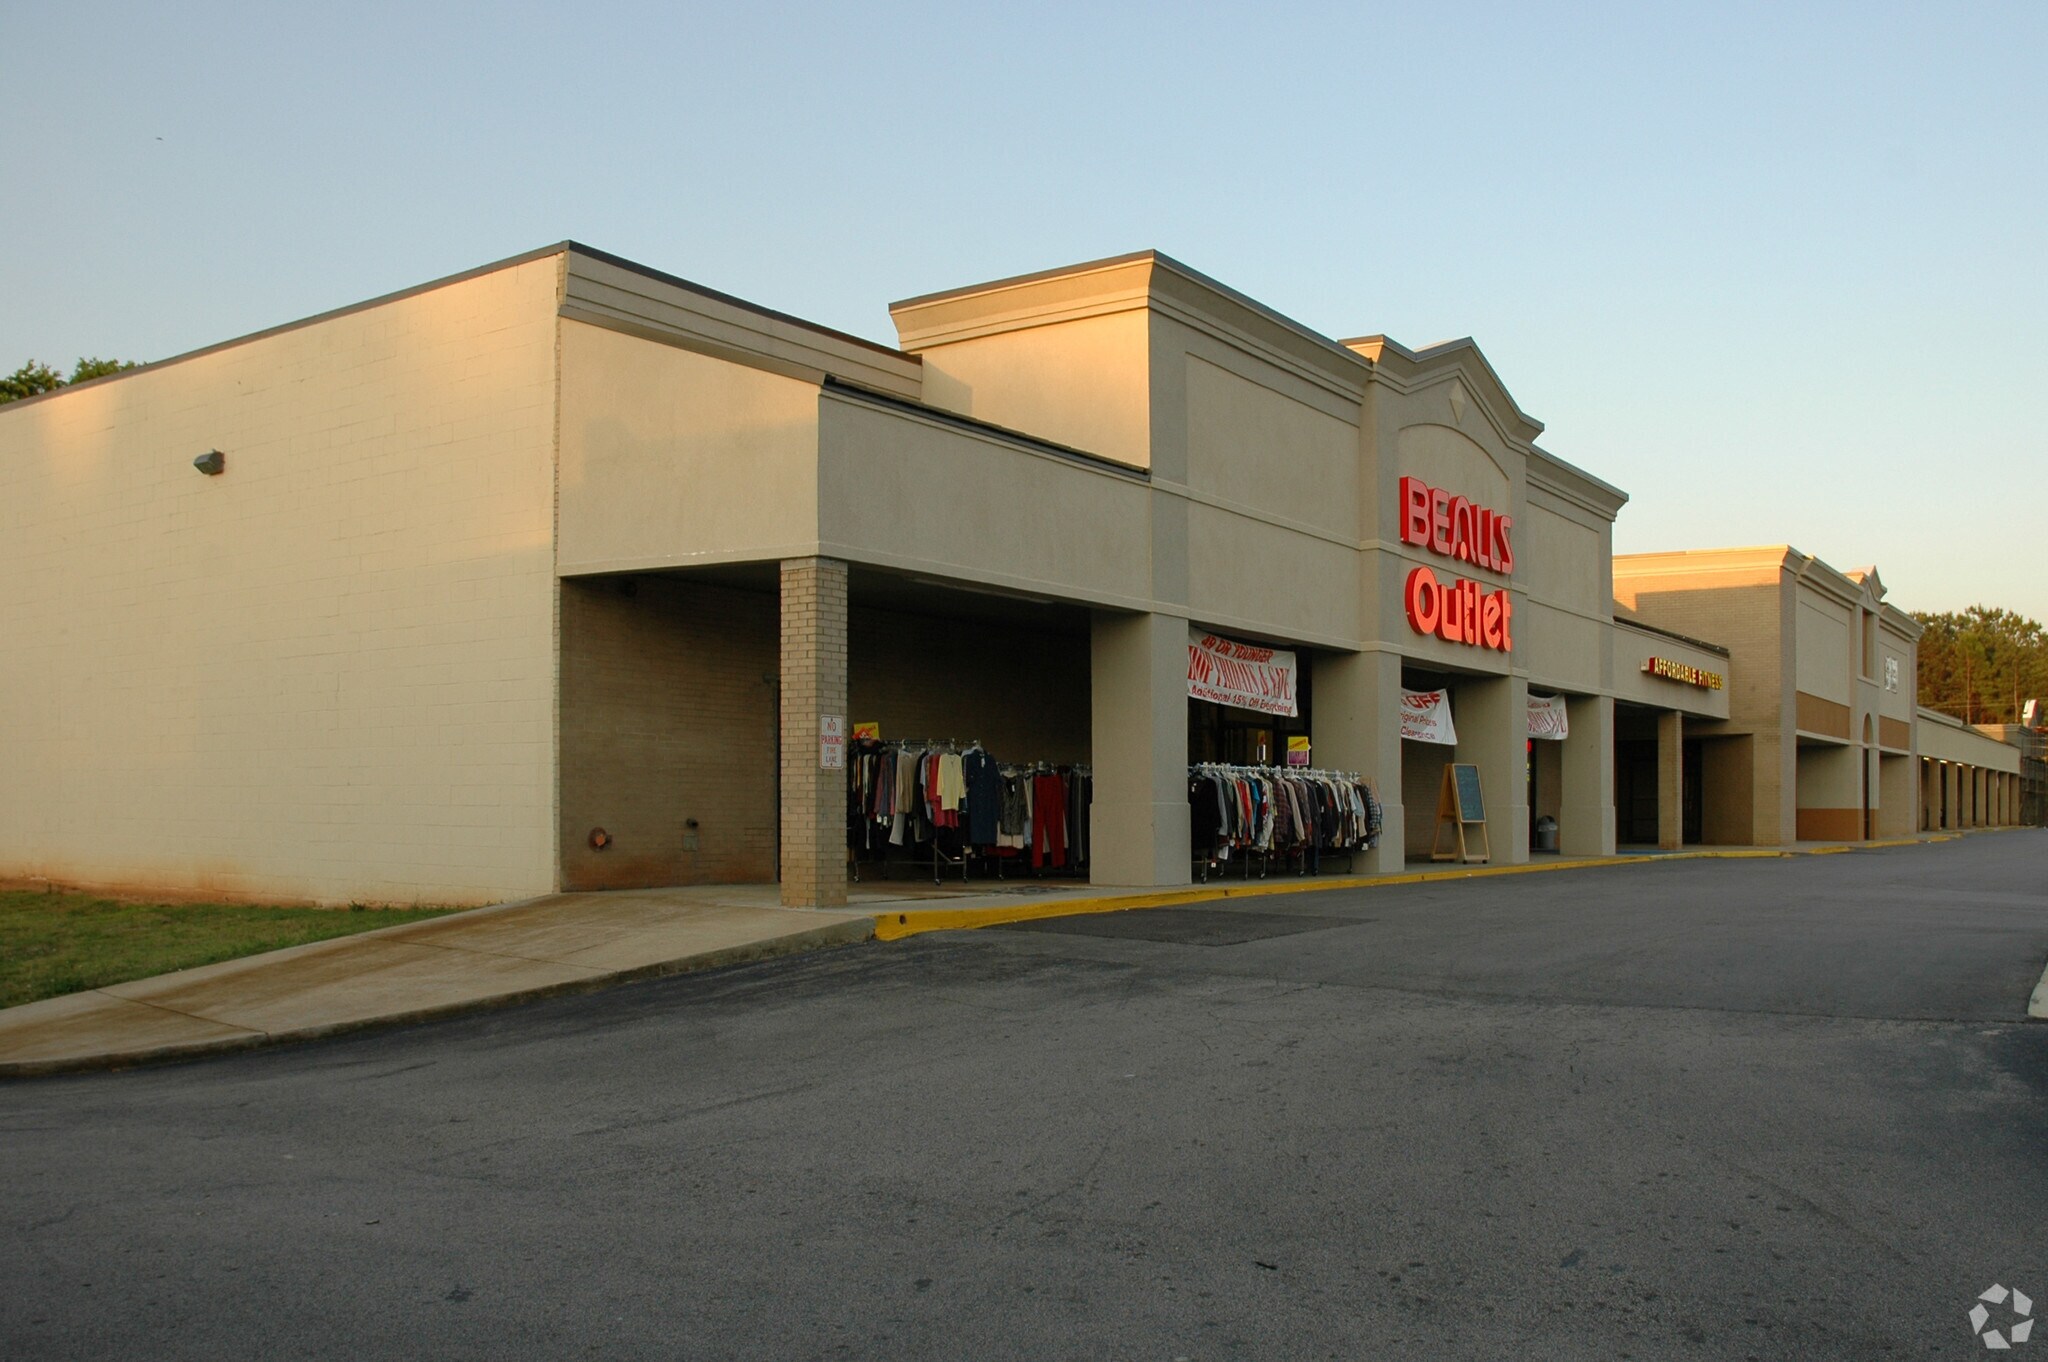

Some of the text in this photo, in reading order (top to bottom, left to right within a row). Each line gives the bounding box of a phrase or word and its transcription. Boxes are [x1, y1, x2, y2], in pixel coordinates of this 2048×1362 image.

[1399, 476, 1515, 576] BEALLS
[1405, 567, 1513, 652] Outlet
[1216, 639, 1232, 655] OR
[1233, 643, 1274, 664] YOUNGER
[1654, 656, 1723, 691] AFFORDABLE FITNESS
[1406, 692, 1440, 709] OFF
[826, 721, 836, 732] NO
[1401, 711, 1420, 724] riginal
[821, 734, 842, 745] PARKING
